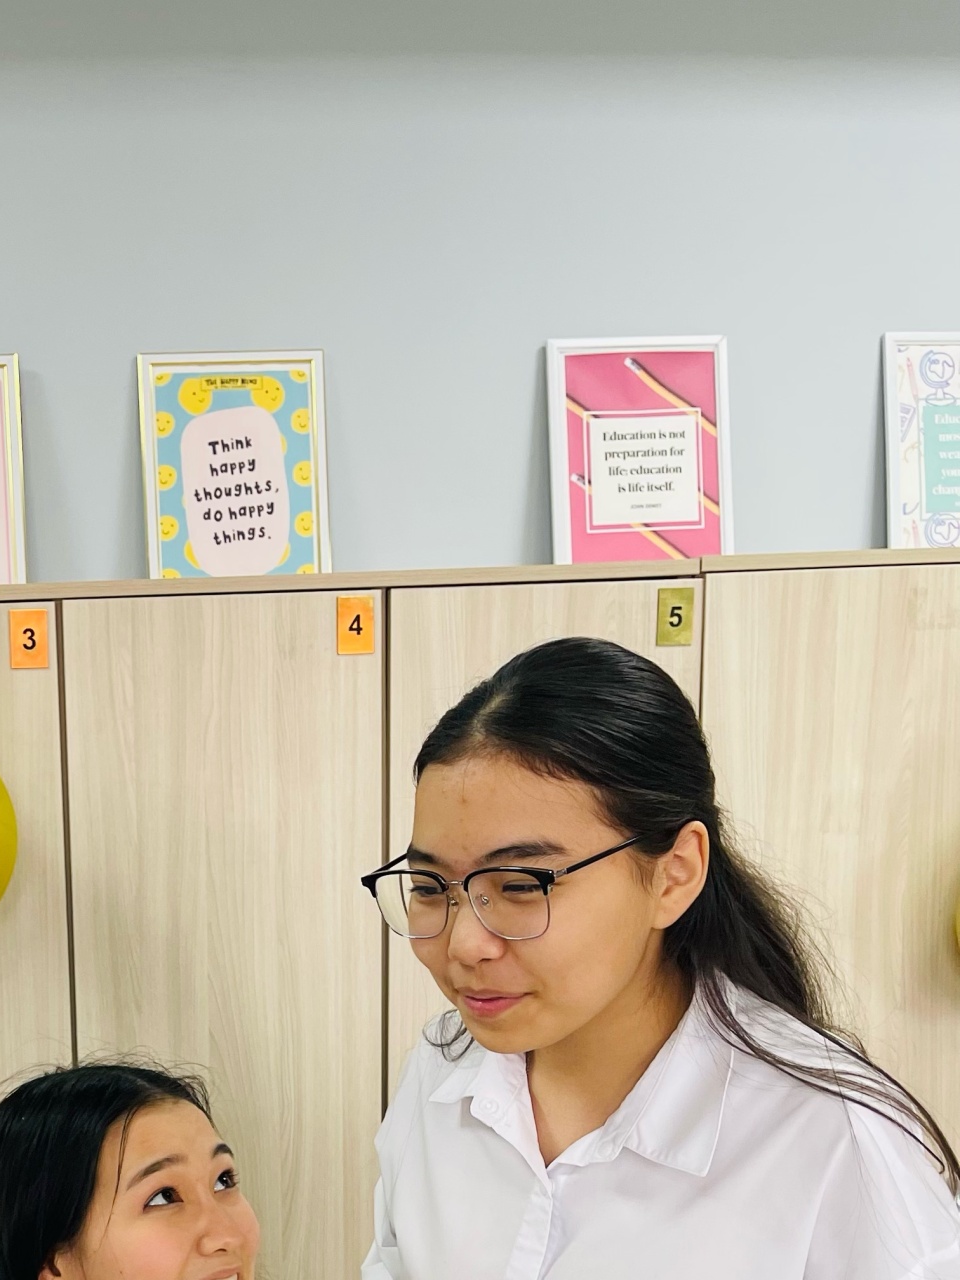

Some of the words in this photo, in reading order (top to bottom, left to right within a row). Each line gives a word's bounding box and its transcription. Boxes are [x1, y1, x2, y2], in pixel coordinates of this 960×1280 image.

[602, 430, 657, 442] Education
[658, 429, 667, 440] is
[668, 430, 686, 440] not
[208, 436, 253, 455] Think
[604, 447, 668, 461] preparation
[669, 446, 685, 457] for
[209, 458, 256, 477] happy
[629, 464, 683, 476] education
[194, 479, 280, 503] thoughts,
[617, 483, 626, 493] is
[628, 482, 645, 493] life
[647, 481, 675, 492] itself.
[203, 507, 223, 522] do
[228, 501, 275, 520] happy
[213, 526, 272, 546] things.
[348, 613, 363, 636] 4
[668, 605, 683, 628] 5
[22, 627, 37, 650] 3
